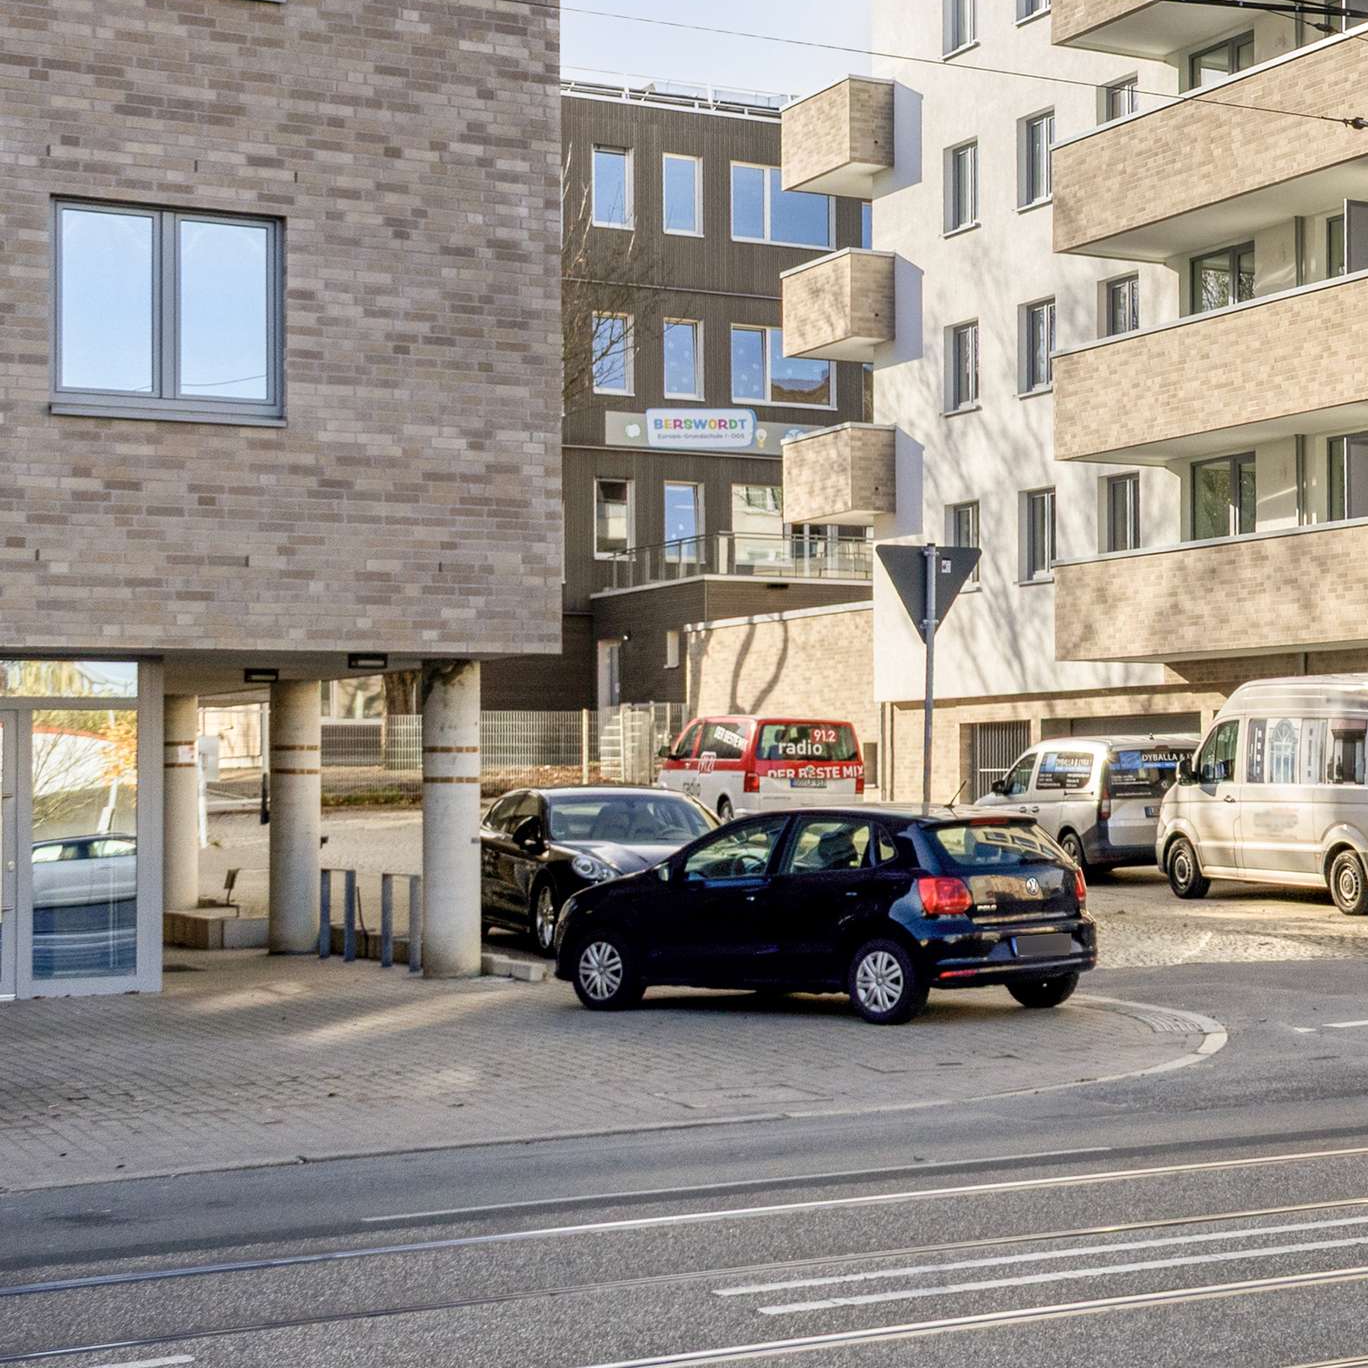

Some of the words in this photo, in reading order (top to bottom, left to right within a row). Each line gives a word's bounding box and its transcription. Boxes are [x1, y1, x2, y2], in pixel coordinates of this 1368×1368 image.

[653, 418, 748, 430] BERSWORDT
[813, 729, 836, 742] 91.2
[778, 739, 822, 755] radio
[1141, 753, 1178, 762] DYBALLA
[767, 768, 795, 778] DER
[799, 765, 840, 779] BESTE
[843, 764, 863, 778] MIX
